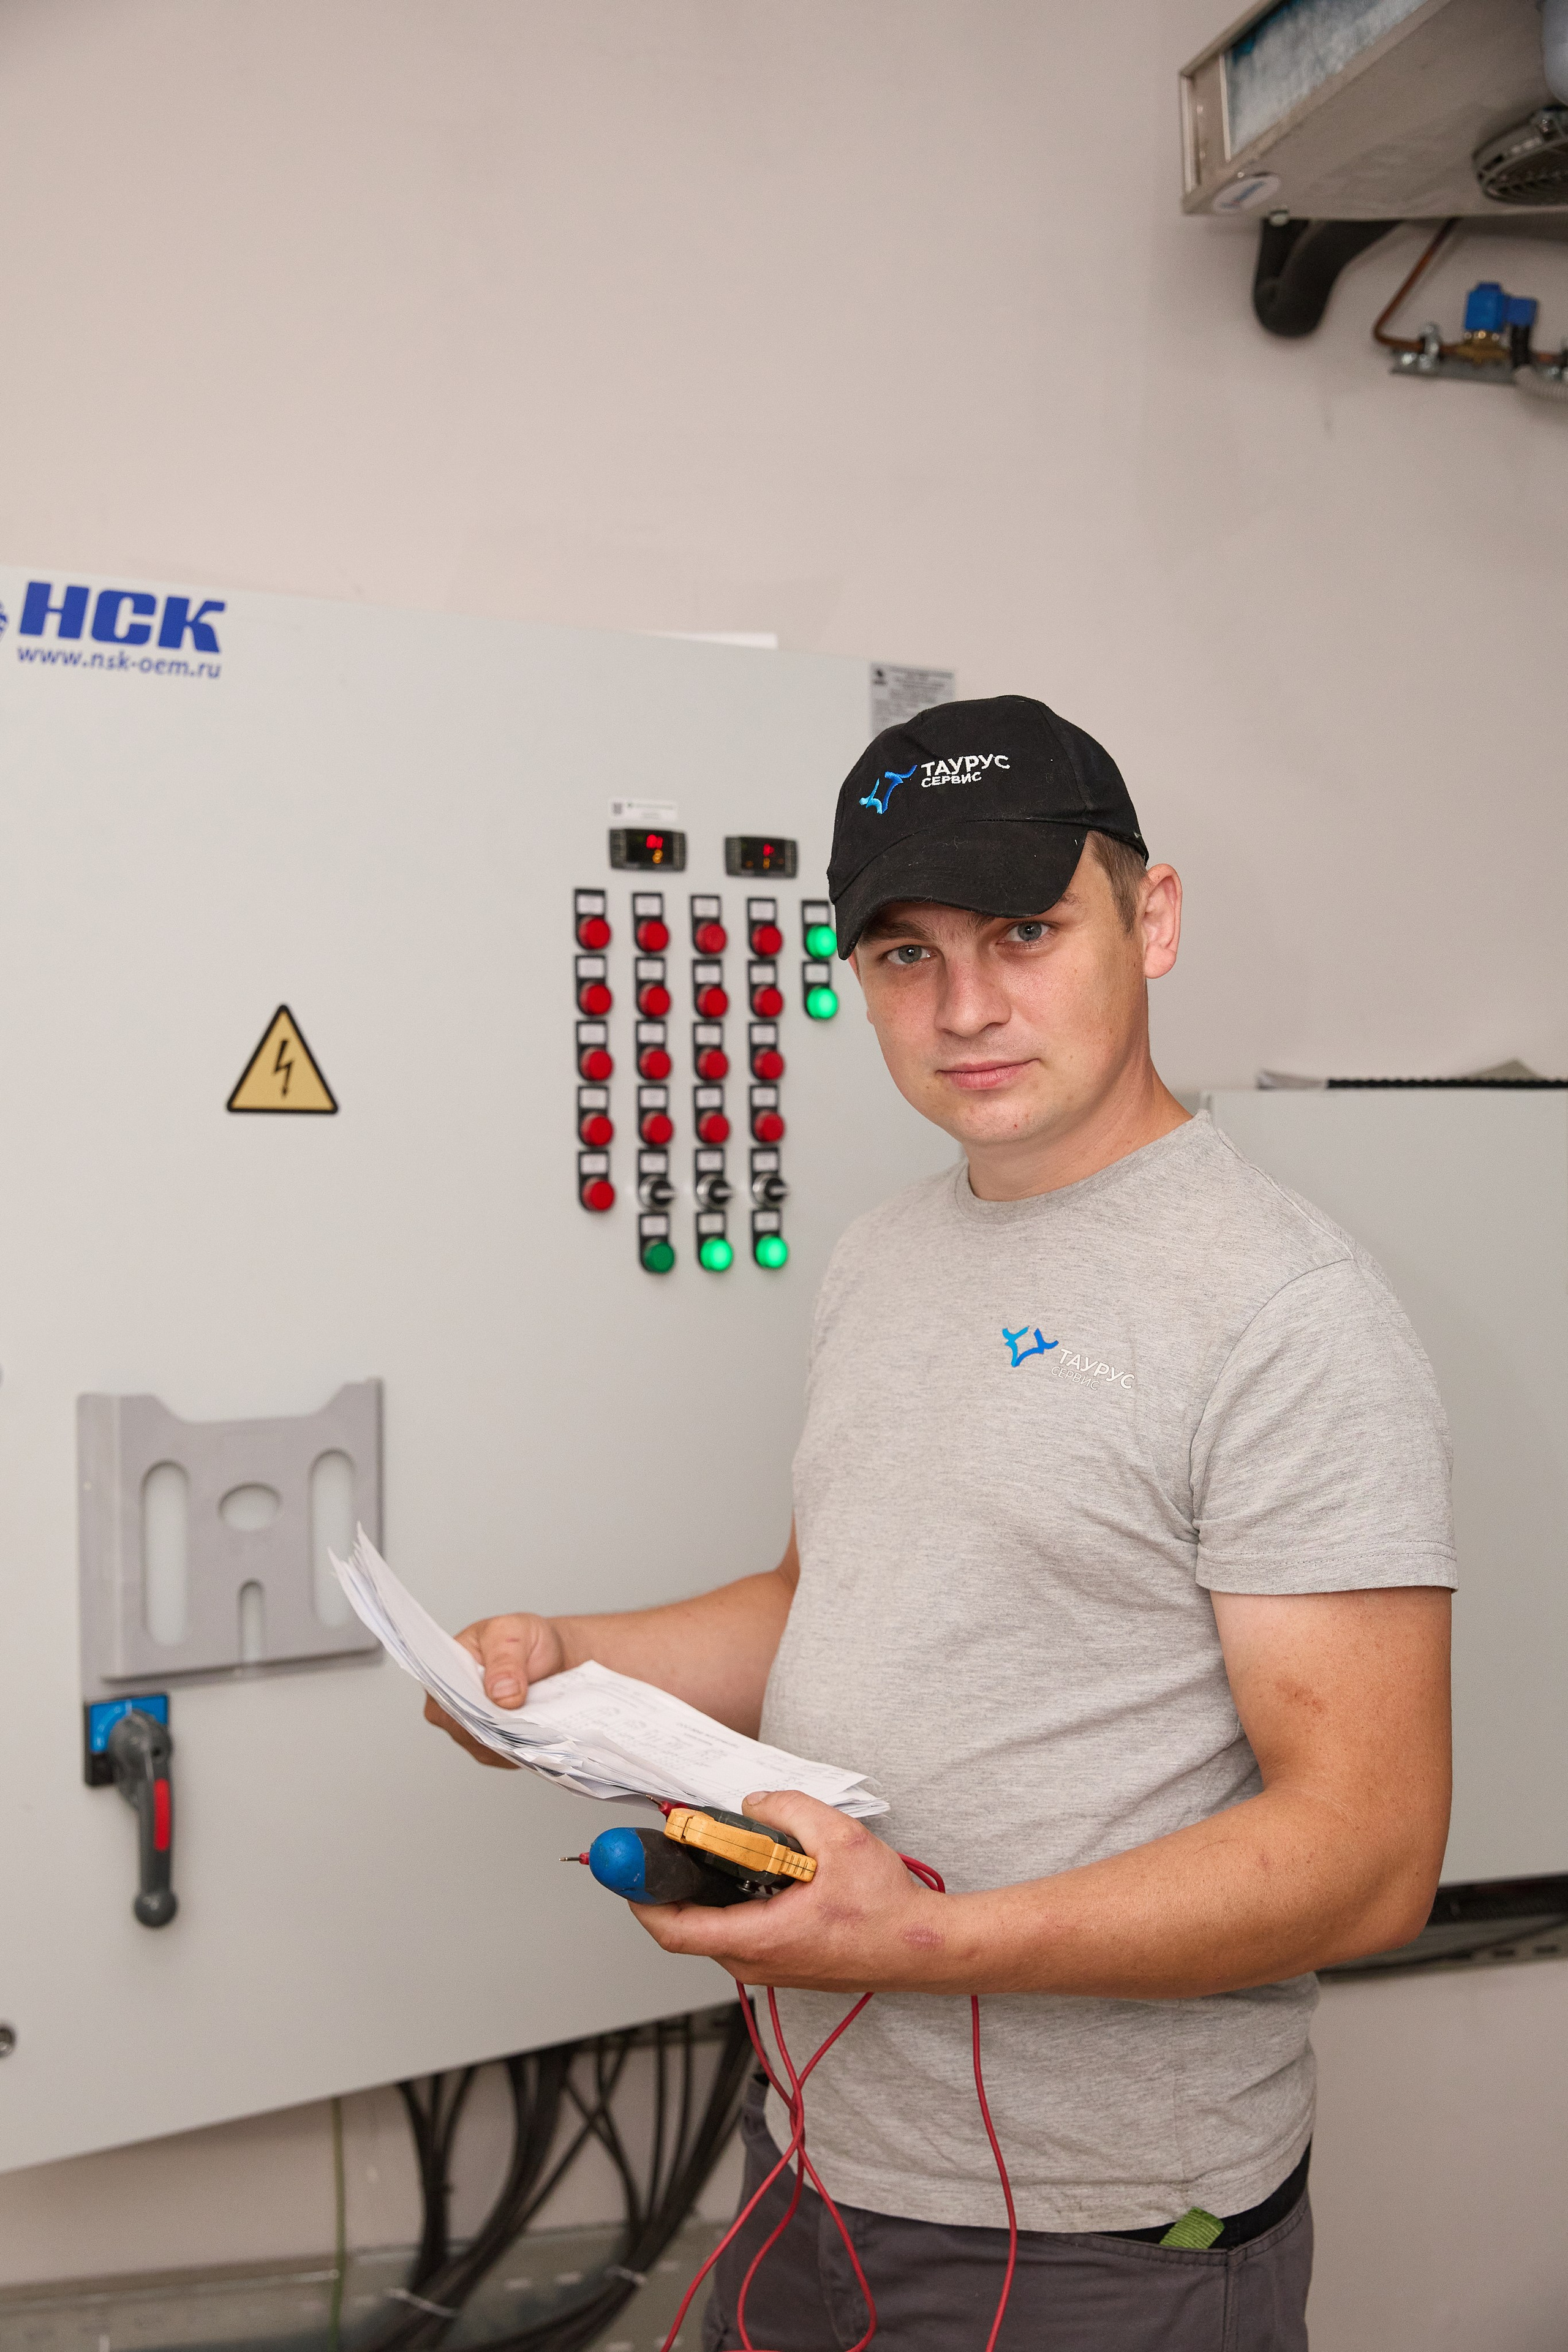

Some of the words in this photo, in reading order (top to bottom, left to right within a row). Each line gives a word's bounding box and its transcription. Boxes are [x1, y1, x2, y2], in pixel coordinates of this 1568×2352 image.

[20, 582, 225, 653] НСК
[18, 647, 221, 678] www.nsk-oem.ru
[921, 754, 1010, 777] ТАУРУС
[921, 772, 982, 788] СЕРВИС
[1051, 1366, 1100, 1390] СЕРВИС
[1059, 1348, 1135, 1389] ТАУРУС
